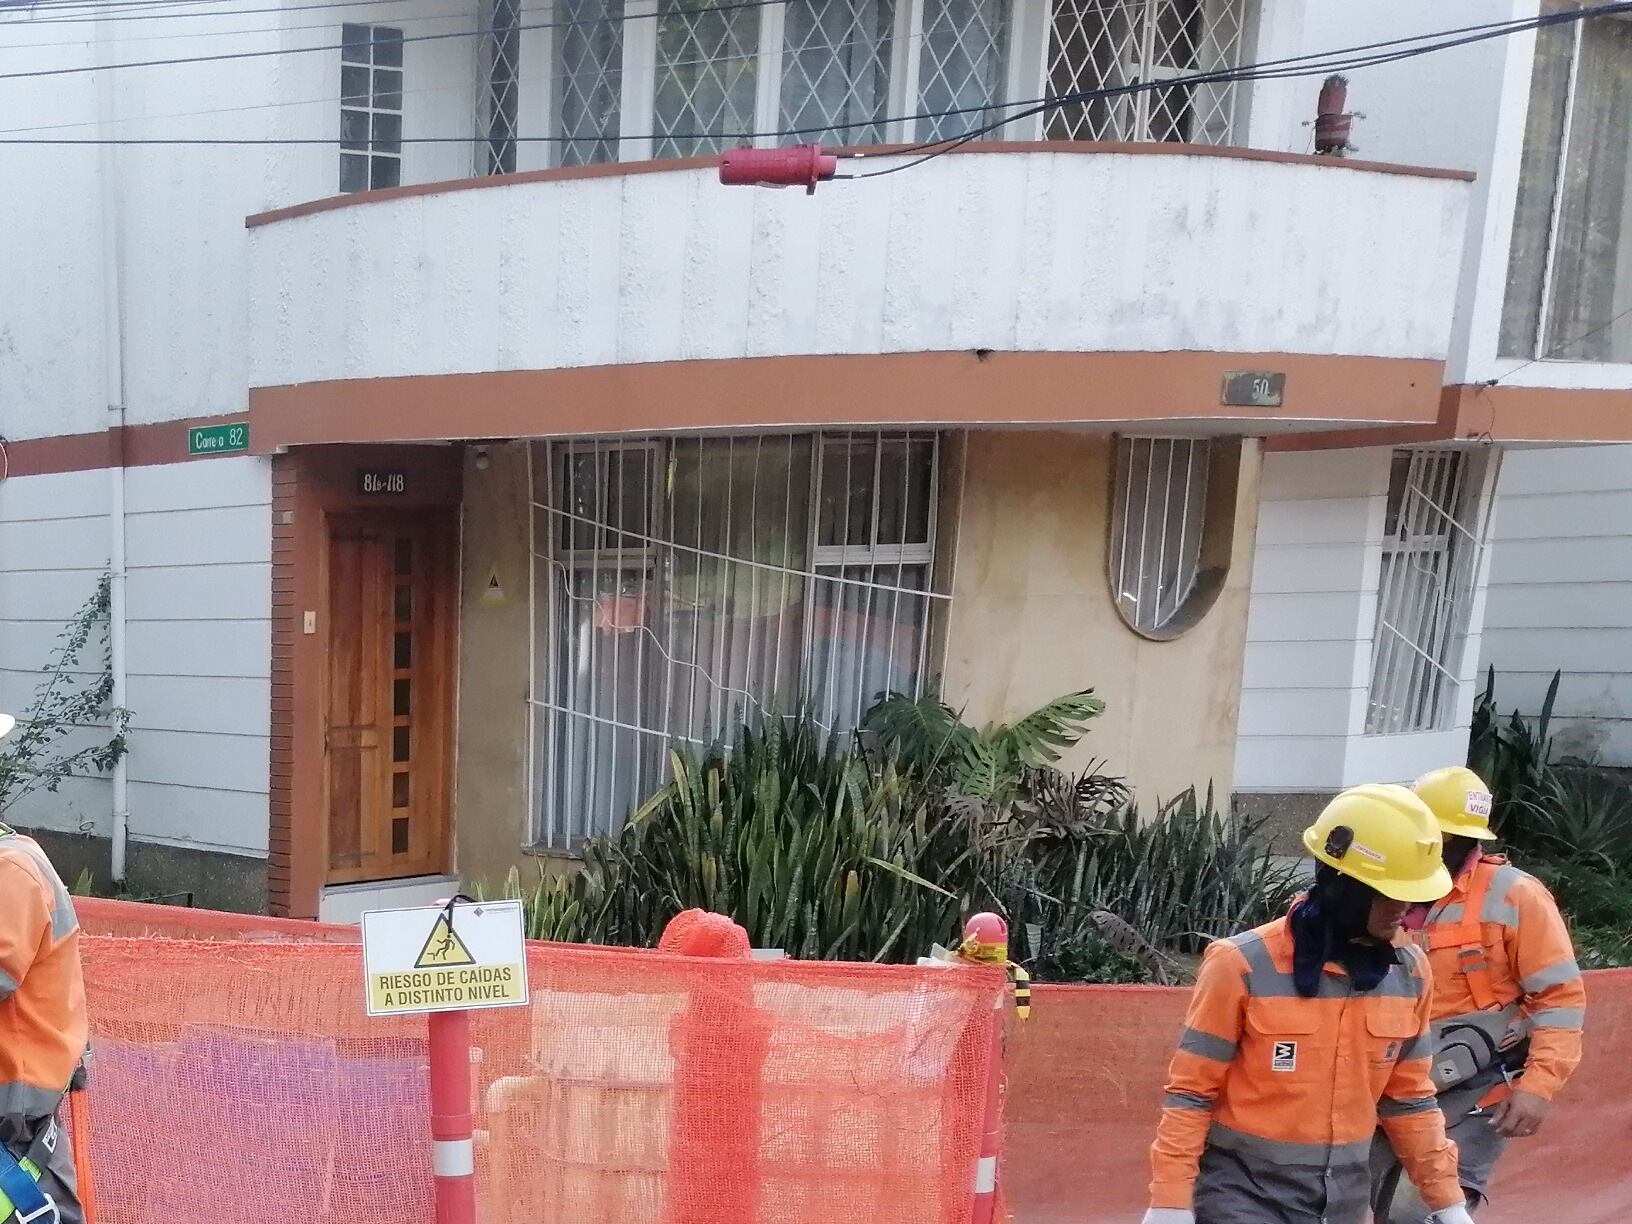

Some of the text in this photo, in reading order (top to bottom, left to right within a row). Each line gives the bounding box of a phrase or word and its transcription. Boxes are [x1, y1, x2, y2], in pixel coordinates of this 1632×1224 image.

[229, 427, 243, 446] 82
[380, 966, 511, 990] RIESGO DE CAÍDAS
[384, 984, 509, 1006] A DISTINTO NIVEL
